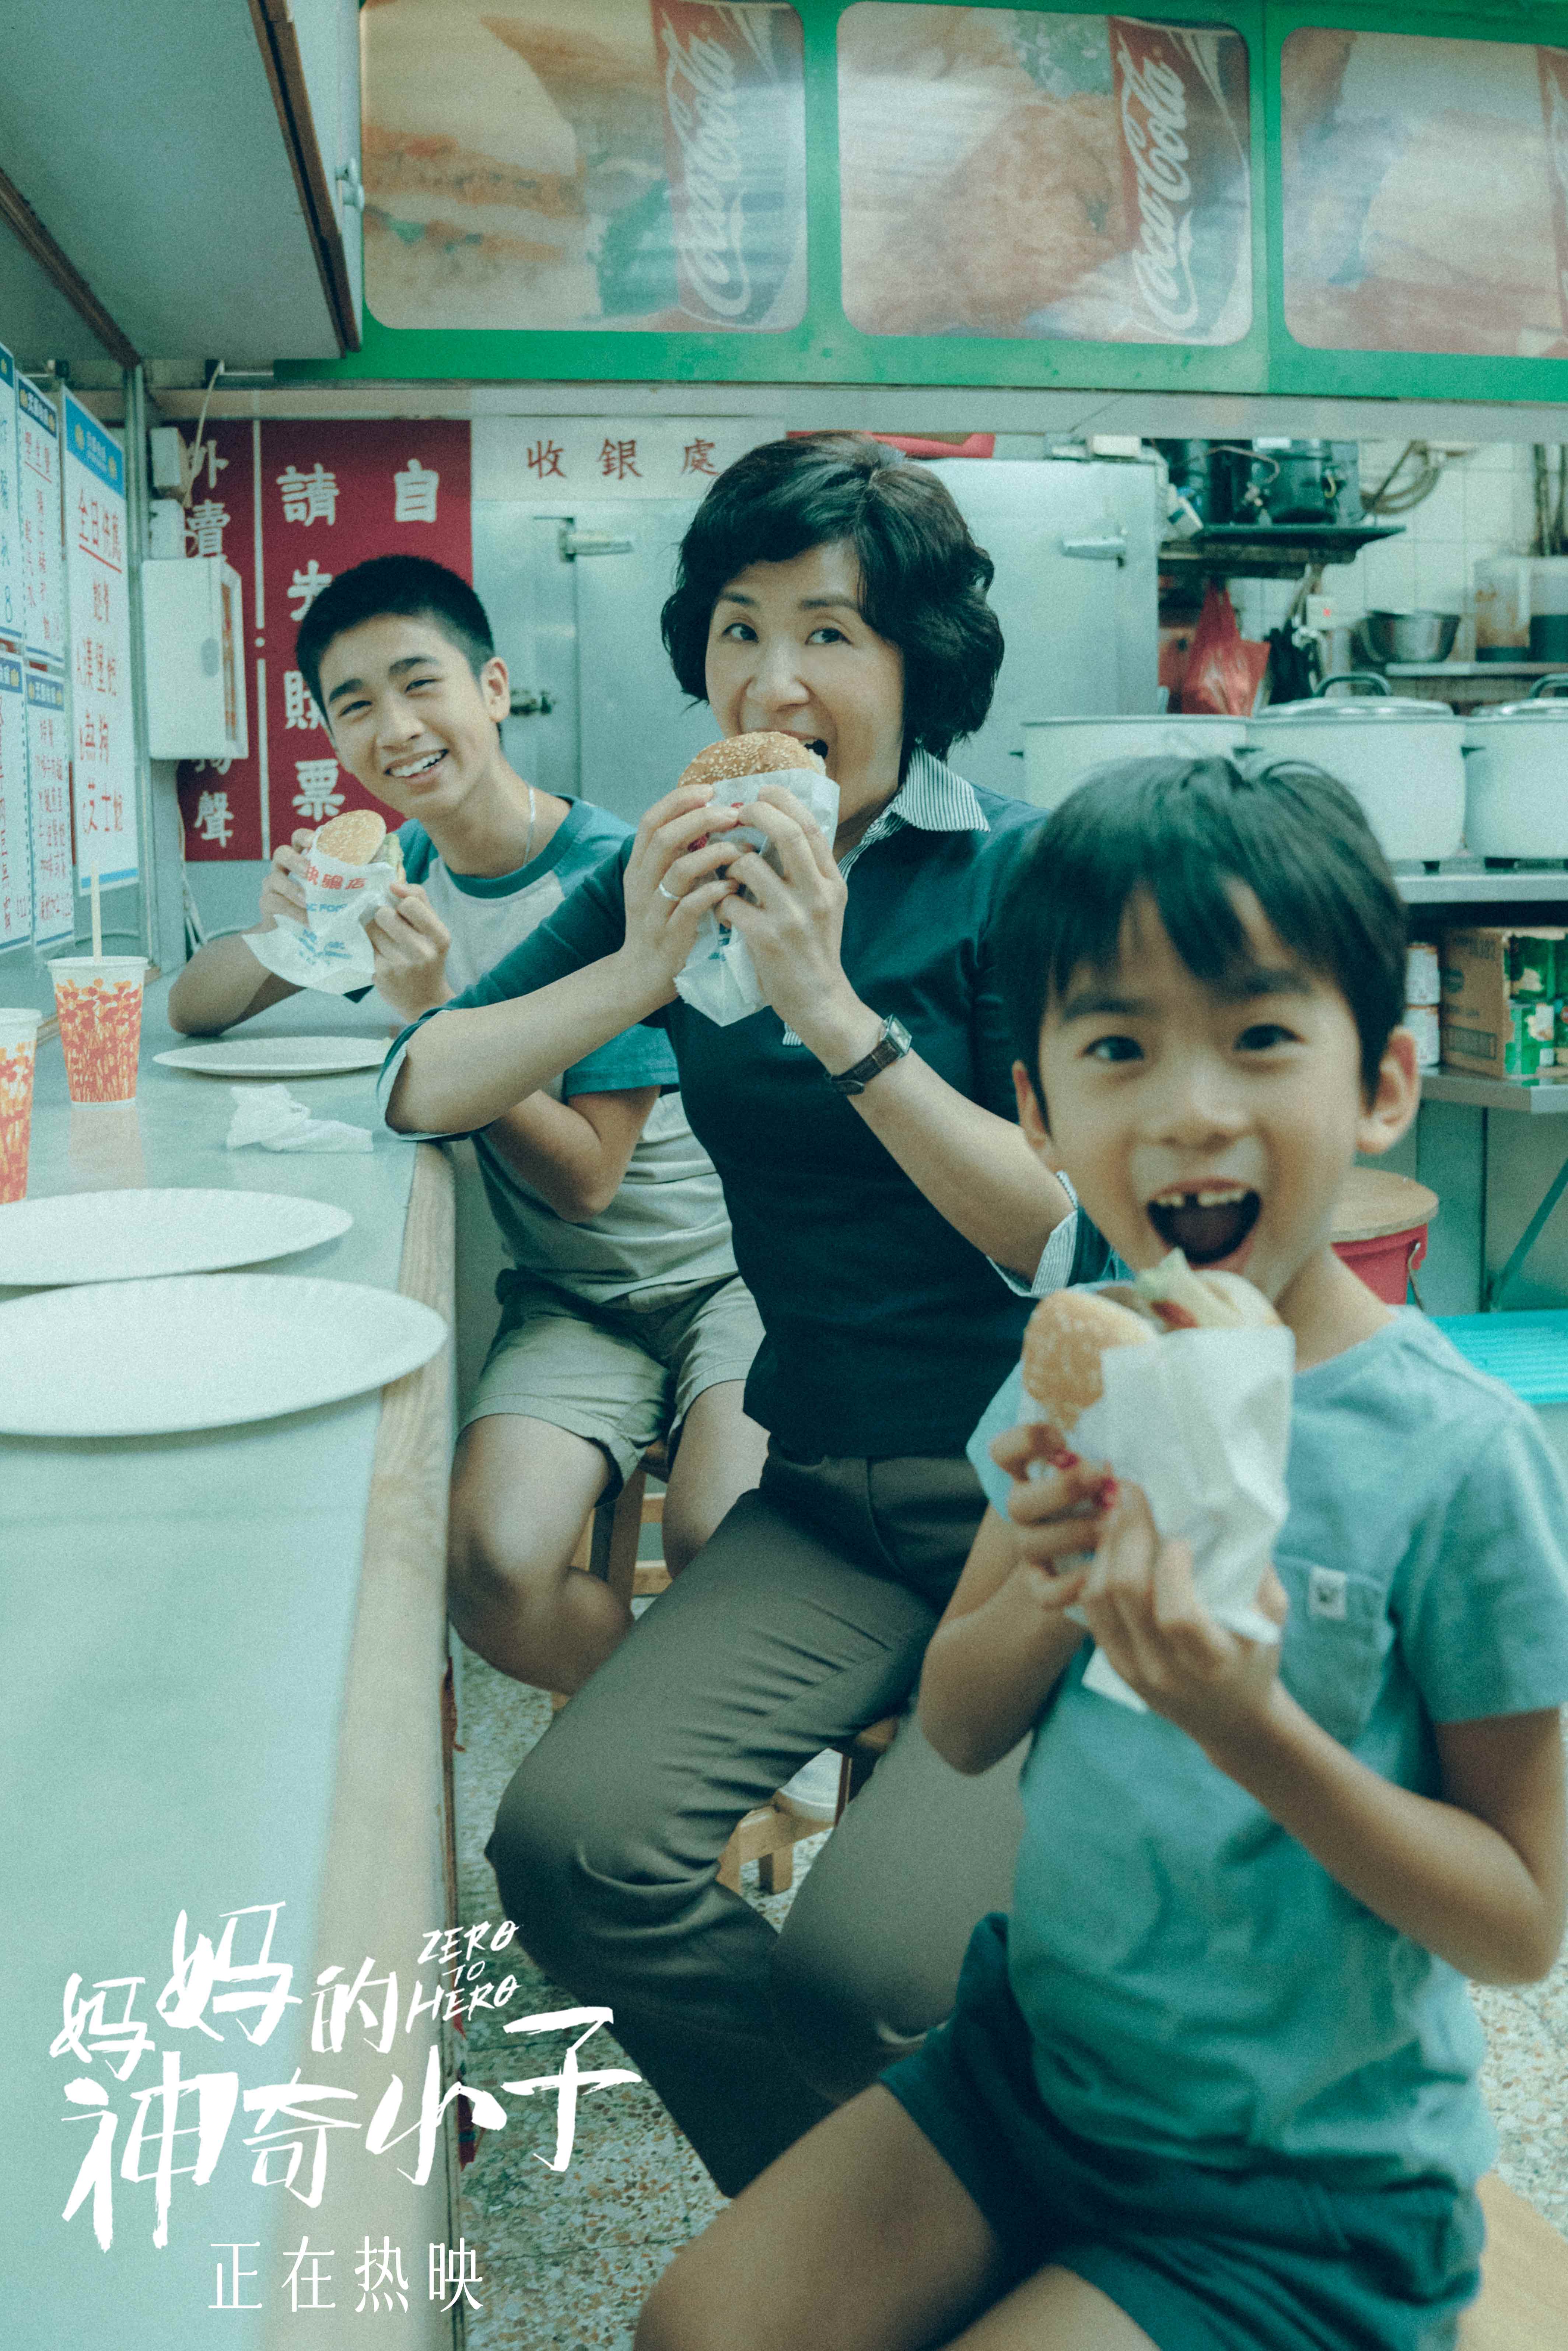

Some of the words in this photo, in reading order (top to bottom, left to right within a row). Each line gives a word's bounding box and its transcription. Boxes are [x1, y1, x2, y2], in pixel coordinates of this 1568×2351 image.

[1117, 30, 1198, 331] Coca-Cola
[394, 459, 439, 522] 自
[526, 438, 720, 480] 收銀處
